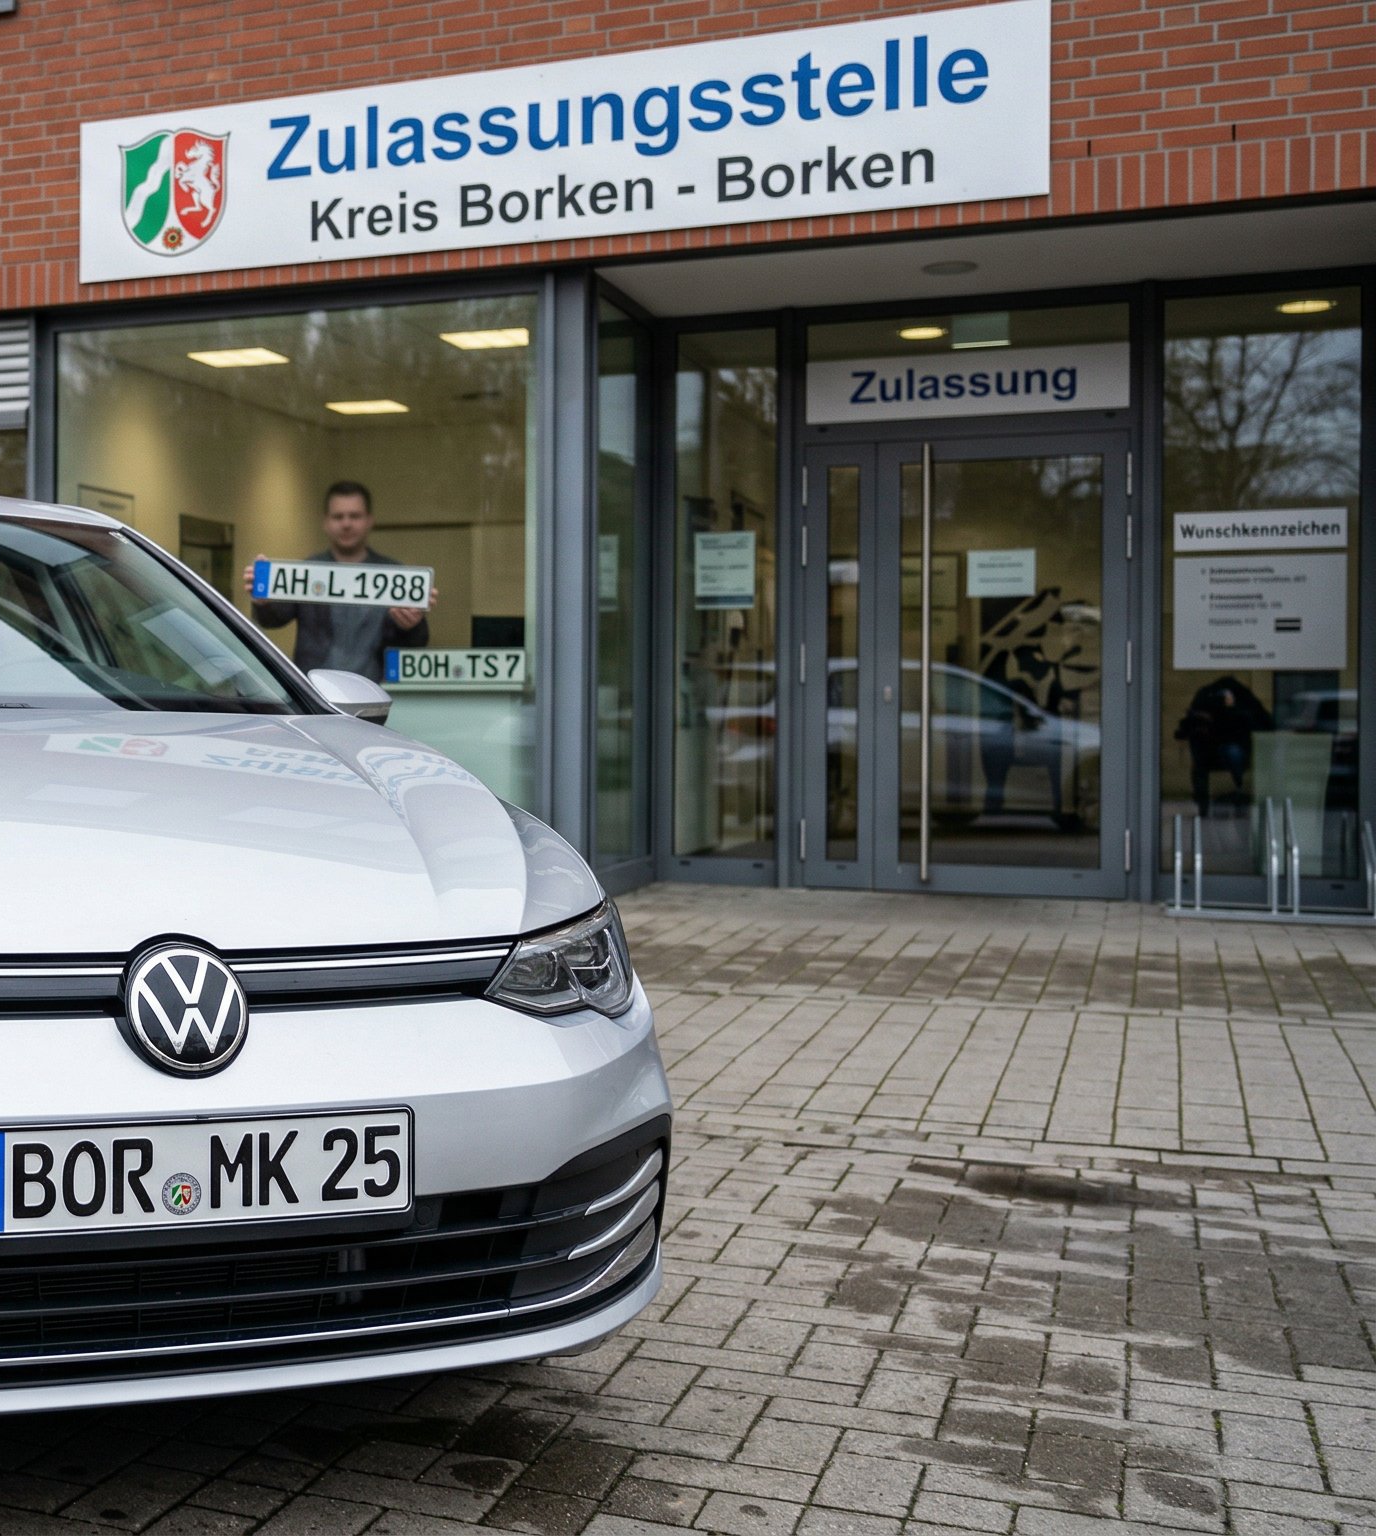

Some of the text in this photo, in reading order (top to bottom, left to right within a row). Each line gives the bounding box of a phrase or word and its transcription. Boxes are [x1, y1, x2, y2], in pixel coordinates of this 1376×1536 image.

[267, 35, 989, 180] Zulassungsstelle
[311, 192, 439, 242] Kreis
[460, 175, 654, 228] Borken
[717, 146, 934, 203] Borken
[849, 366, 1078, 404] Zulassung
[1180, 520, 1342, 539] Wunschkennzeichen
[272, 567, 309, 596] AH
[327, 570, 345, 598] L
[353, 572, 425, 603] 1988
[401, 653, 521, 679] BOH TS 7
[12, 1138, 156, 1220] BOR
[210, 1130, 300, 1210] MK
[321, 1124, 401, 1202] 25
